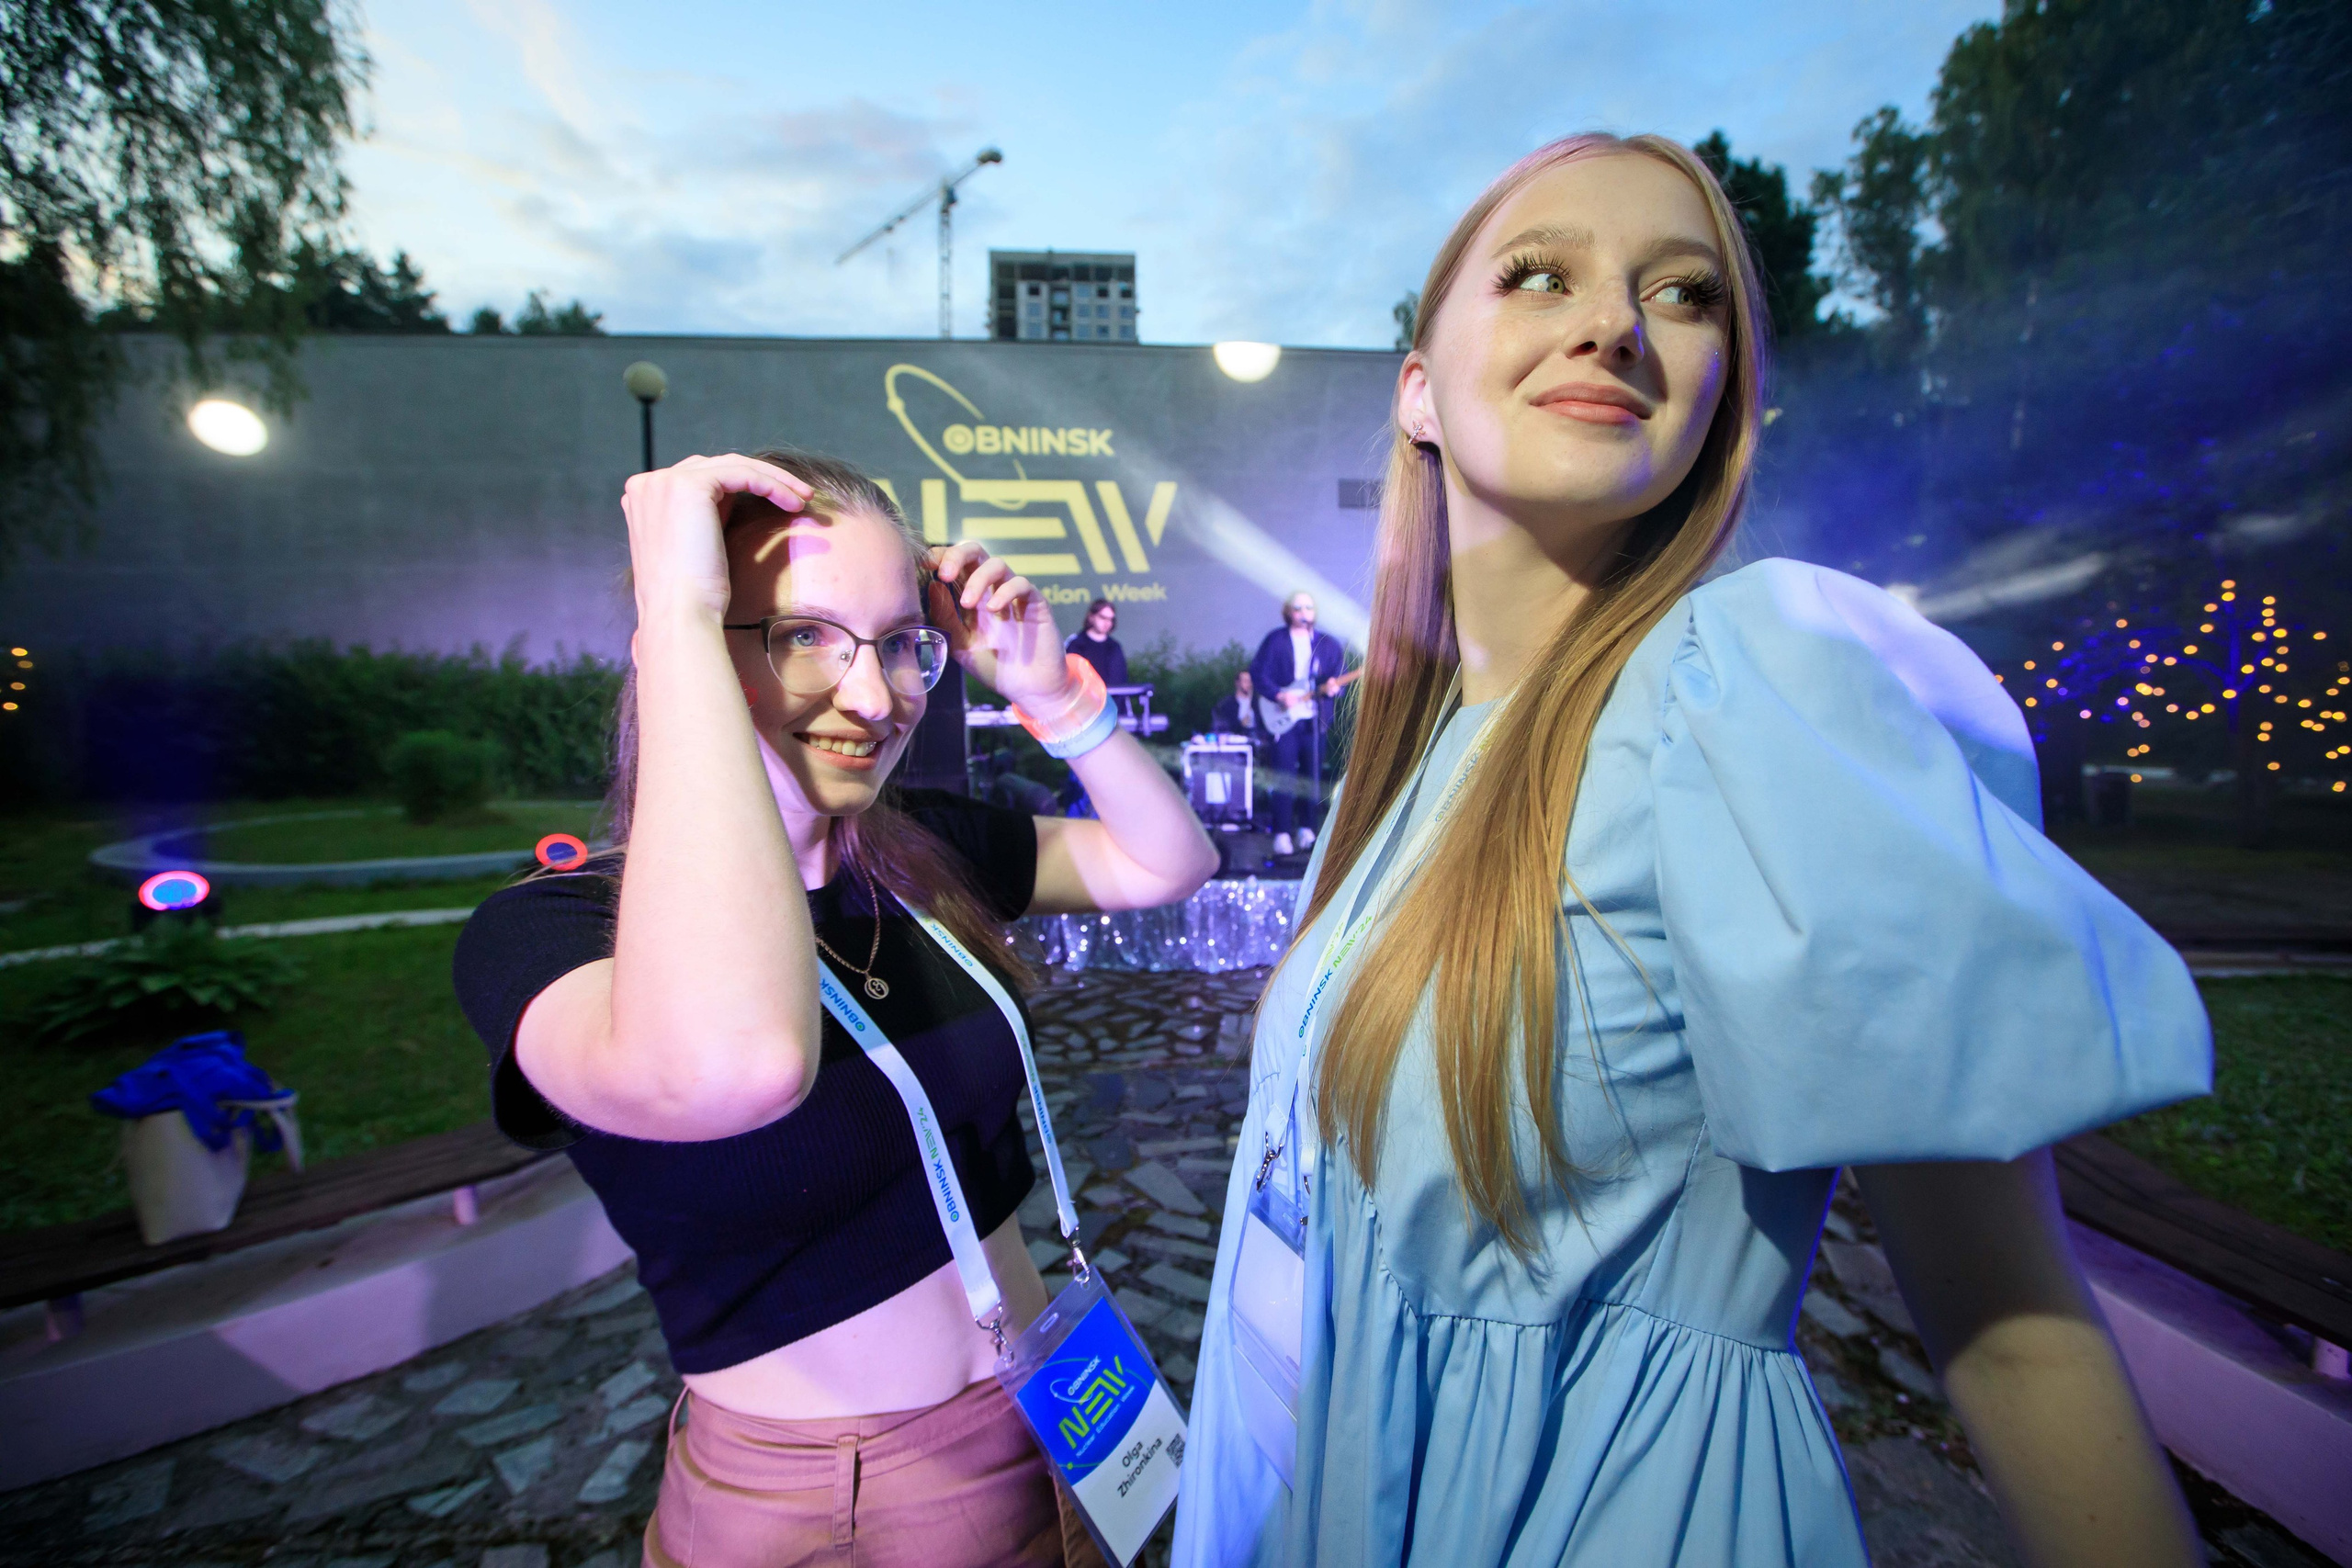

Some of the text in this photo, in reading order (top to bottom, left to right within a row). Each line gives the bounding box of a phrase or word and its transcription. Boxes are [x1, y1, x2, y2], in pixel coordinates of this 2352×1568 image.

[943, 423, 1114, 457] OBNINSK
[1102, 582, 1167, 604] Week
[930, 923, 973, 967] OBNINSK
[820, 978, 865, 1032] OBNINSK
[1298, 968, 1332, 1039] OBNINSK
[933, 1158, 960, 1223] OBNINSK
[1067, 1355, 1102, 1396] OBNINSK
[1058, 1355, 1126, 1450] NEW
[1116, 1438, 1163, 1498] Zhironkina
[1122, 1441, 1144, 1468] Olga
